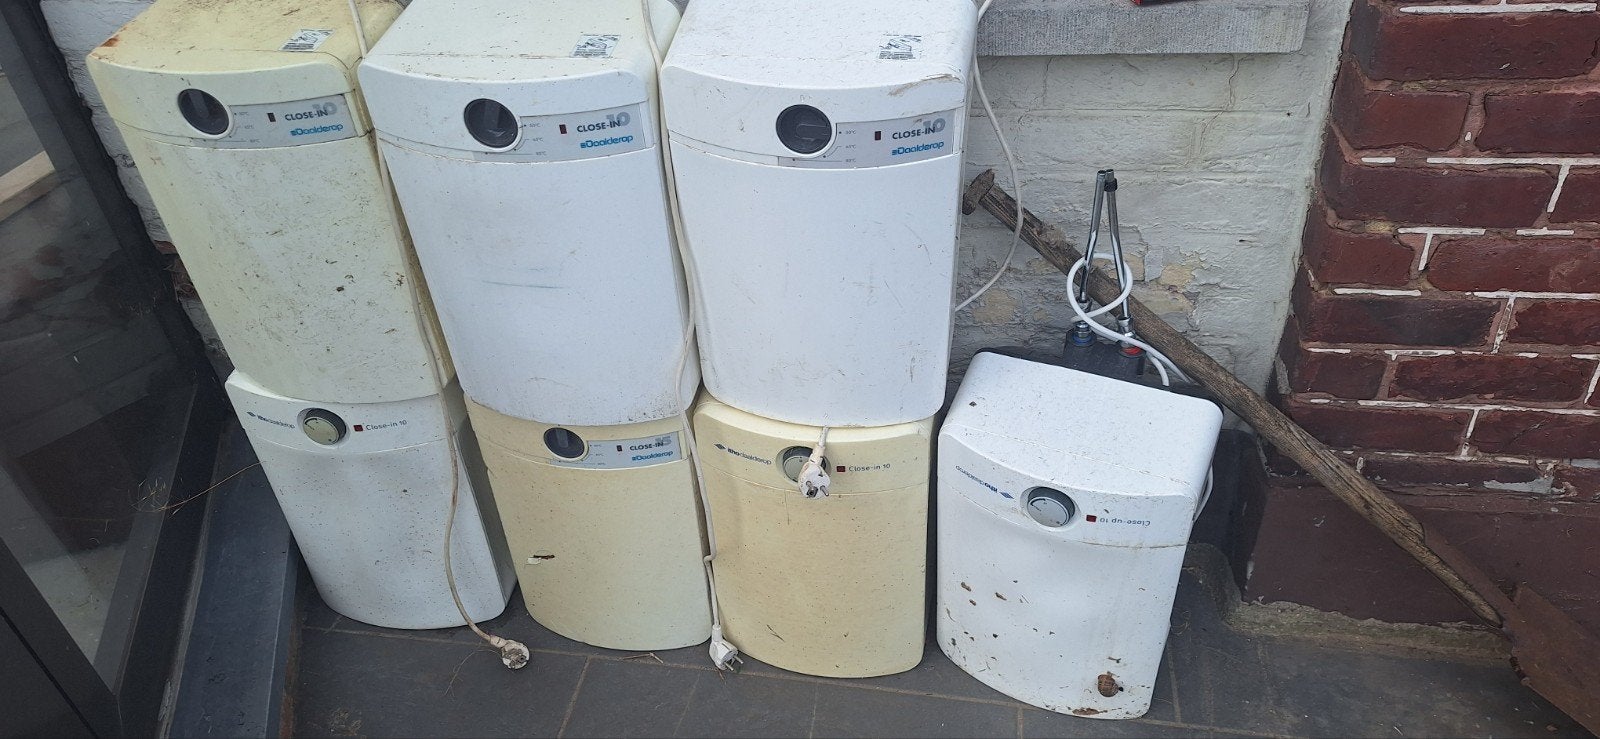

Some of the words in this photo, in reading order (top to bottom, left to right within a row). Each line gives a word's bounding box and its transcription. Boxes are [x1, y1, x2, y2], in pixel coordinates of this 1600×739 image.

[285, 109, 328, 121] CLOSE-IN
[294, 123, 344, 137] Daalderop
[576, 119, 621, 133] CLOSE-IN
[892, 126, 936, 140] CLOSE-IN
[585, 135, 634, 148] Daalderop
[896, 141, 945, 155] Daalderop
[365, 421, 398, 431] Close-in
[629, 441, 664, 451] CLOSE-IN
[848, 464, 881, 472] Close-in
